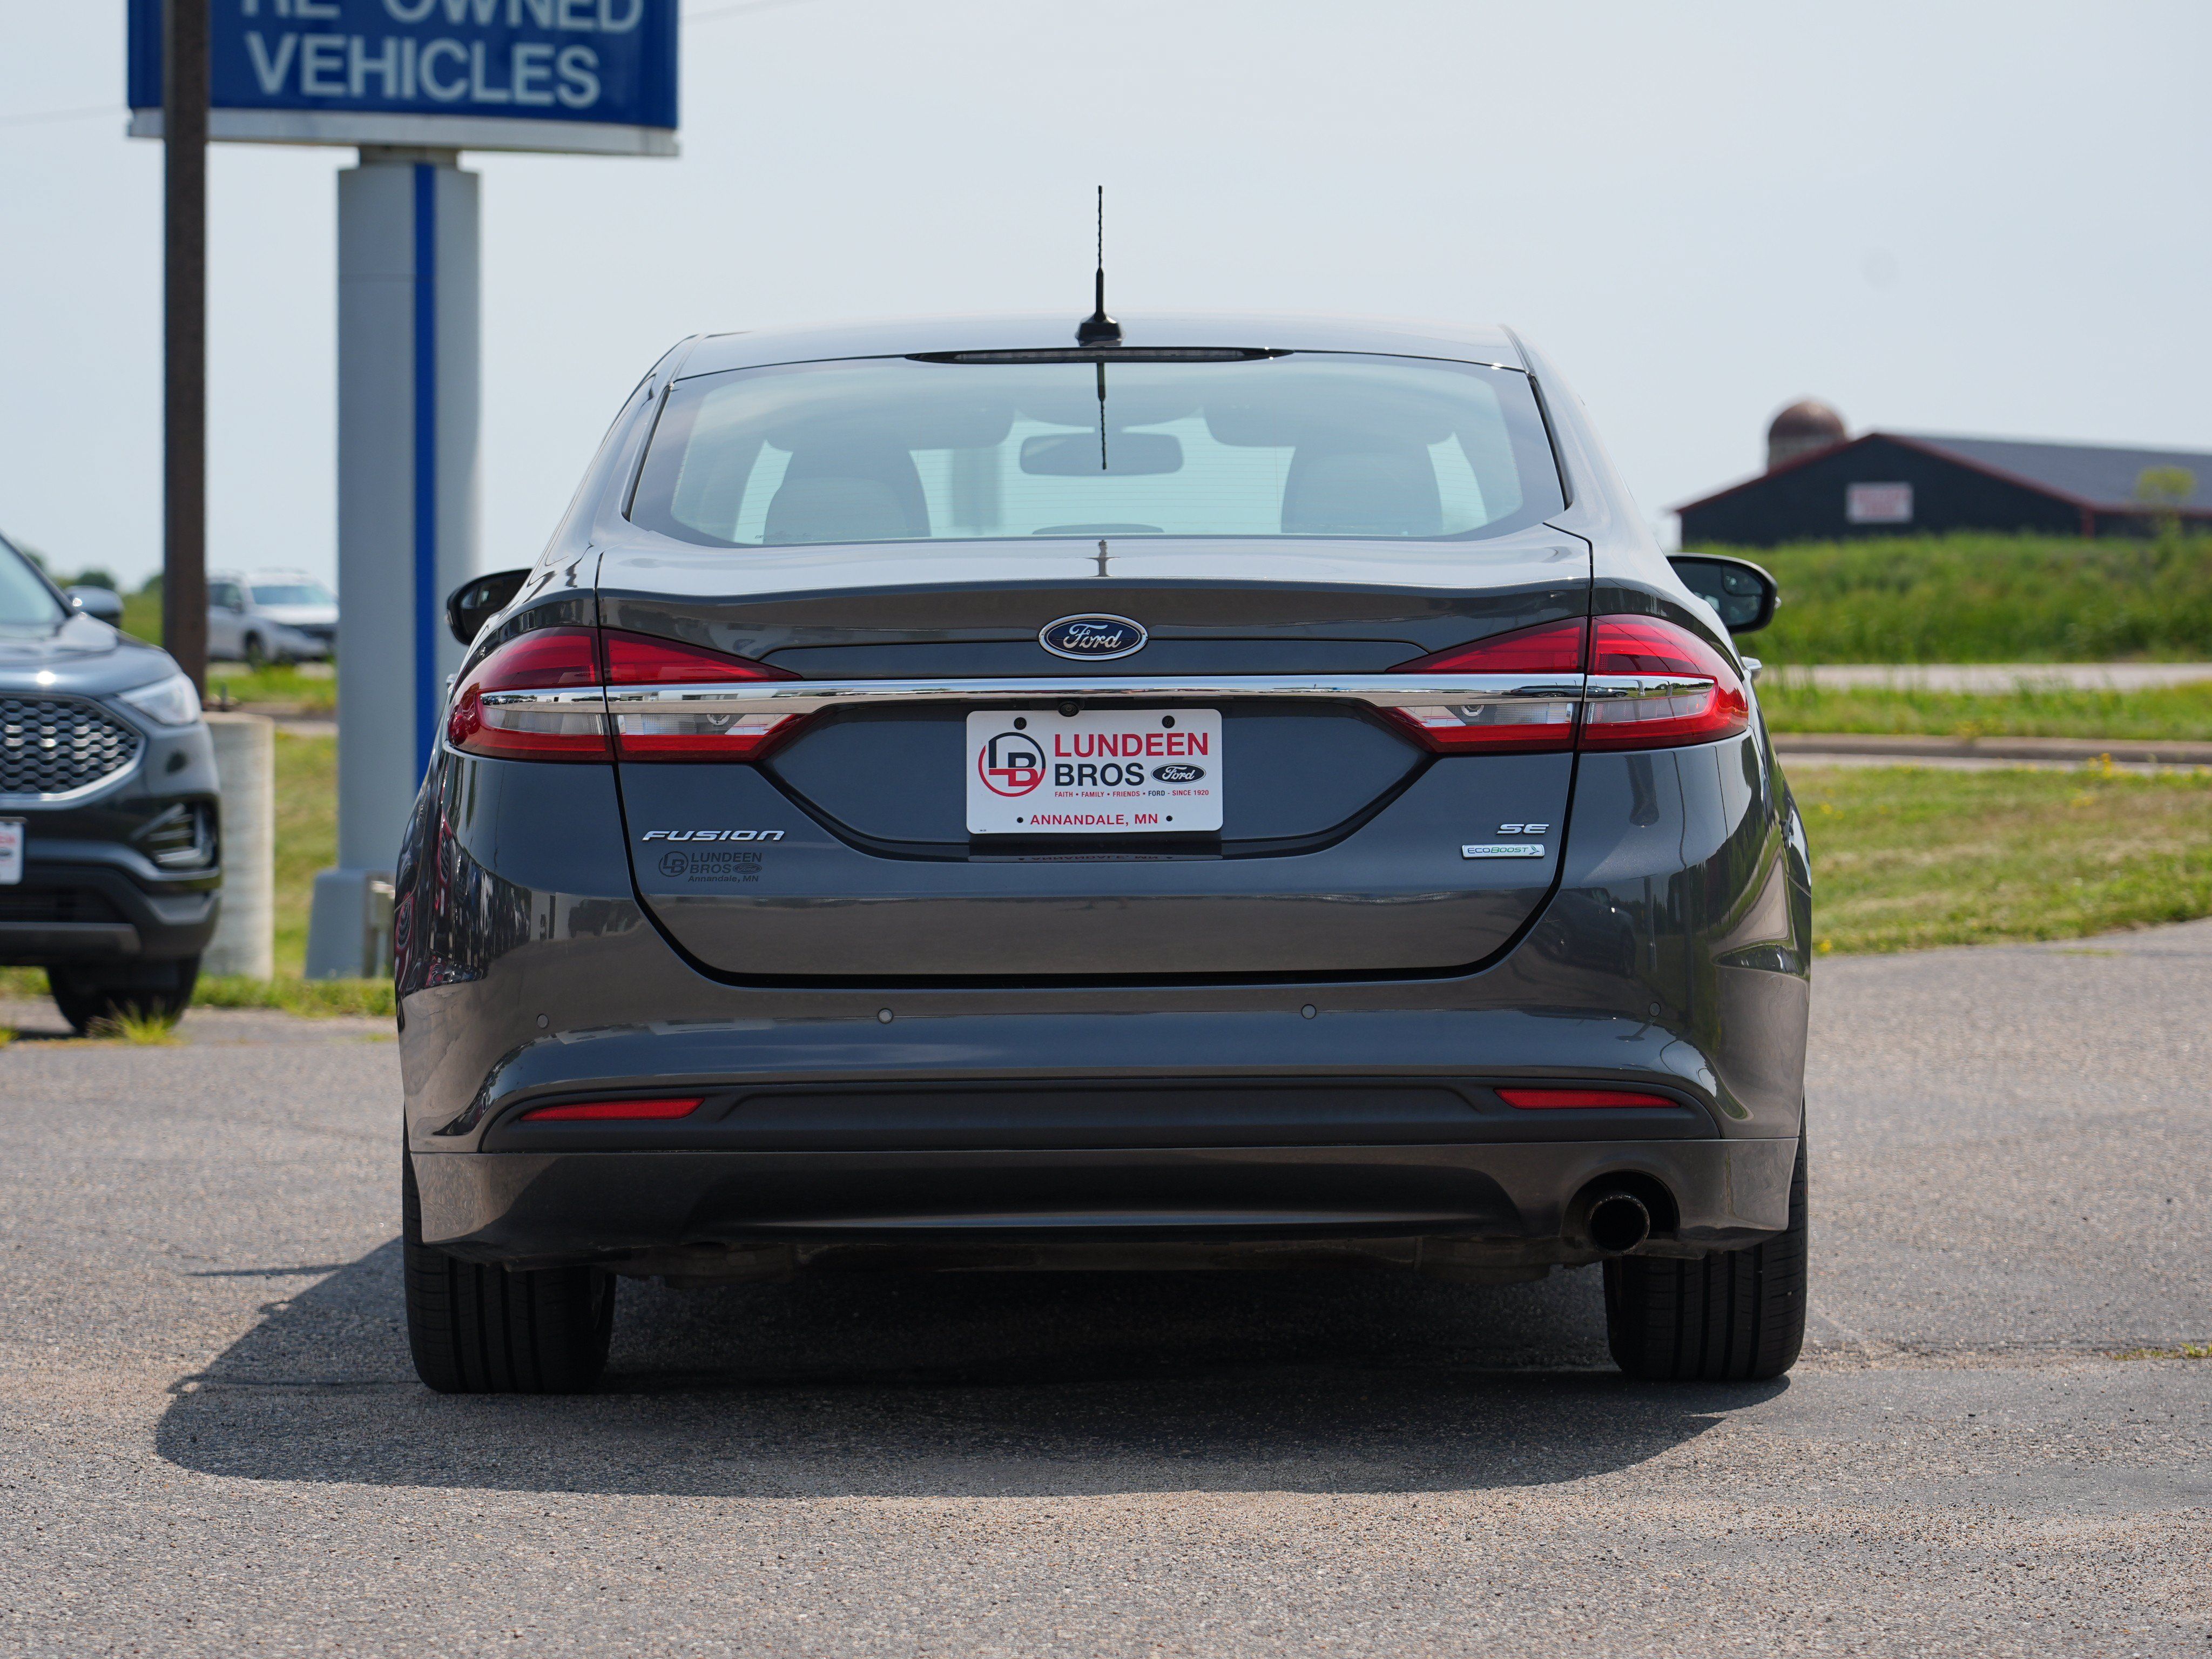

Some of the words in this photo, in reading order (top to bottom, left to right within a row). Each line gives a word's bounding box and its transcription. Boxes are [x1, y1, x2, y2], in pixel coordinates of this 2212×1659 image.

[246, 32, 601, 107] VEHICLES
[1063, 623, 1123, 649] Ford
[1055, 732, 1208, 758] LUNDEEN
[1055, 762, 1144, 787] BROS
[1162, 766, 1196, 781] Ford
[1030, 814, 1129, 826] ANNANDALE,
[1135, 814, 1158, 824] MN
[642, 830, 785, 841] FUSION
[1496, 824, 1549, 834] SE
[691, 852, 762, 862] LUNDEEN
[690, 864, 731, 874] BROS
